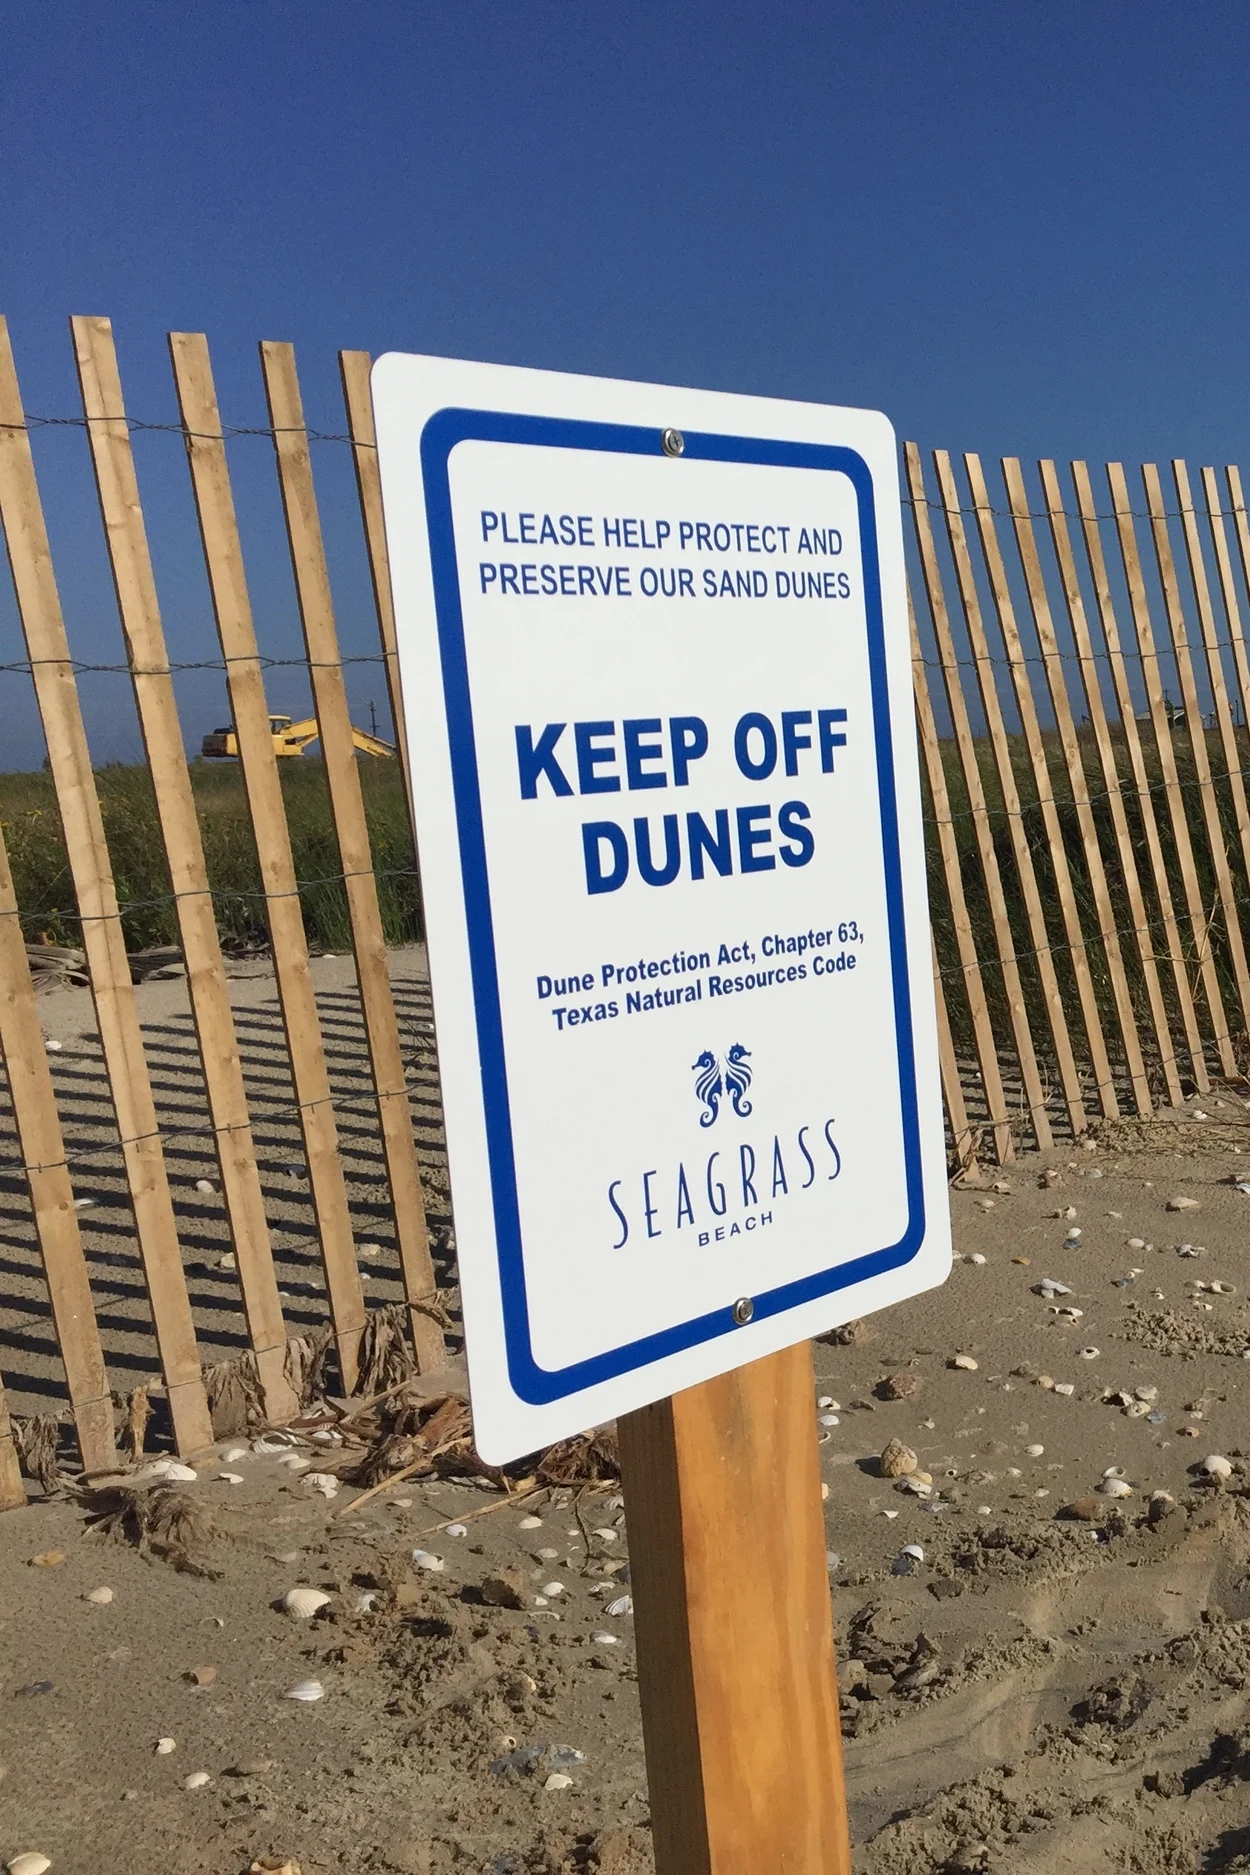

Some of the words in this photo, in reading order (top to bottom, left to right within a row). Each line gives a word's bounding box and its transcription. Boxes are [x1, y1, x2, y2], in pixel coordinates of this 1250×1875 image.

[481, 511, 595, 546] PLEASE
[604, 518, 670, 548] HELP
[679, 522, 790, 553] PROTECT
[798, 528, 842, 555] AND
[480, 563, 631, 595] PRESERVE
[640, 568, 695, 597] OUR
[703, 569, 767, 597] SAND
[776, 571, 850, 598] DUNES
[515, 716, 708, 800] KEEP
[734, 709, 847, 780] OFF
[582, 801, 814, 895] DUNES
[537, 974, 594, 999] Dune
[602, 951, 710, 987] Protection
[718, 941, 755, 965] Act,
[762, 930, 832, 956] Chapter
[838, 921, 863, 943] 63,
[552, 1002, 618, 1030] Texas
[626, 979, 701, 1014] Natural
[709, 965, 807, 997] Resources
[813, 952, 856, 975] Code
[609, 1119, 840, 1249] SEAGRASS
[699, 1211, 772, 1246] BEACH
